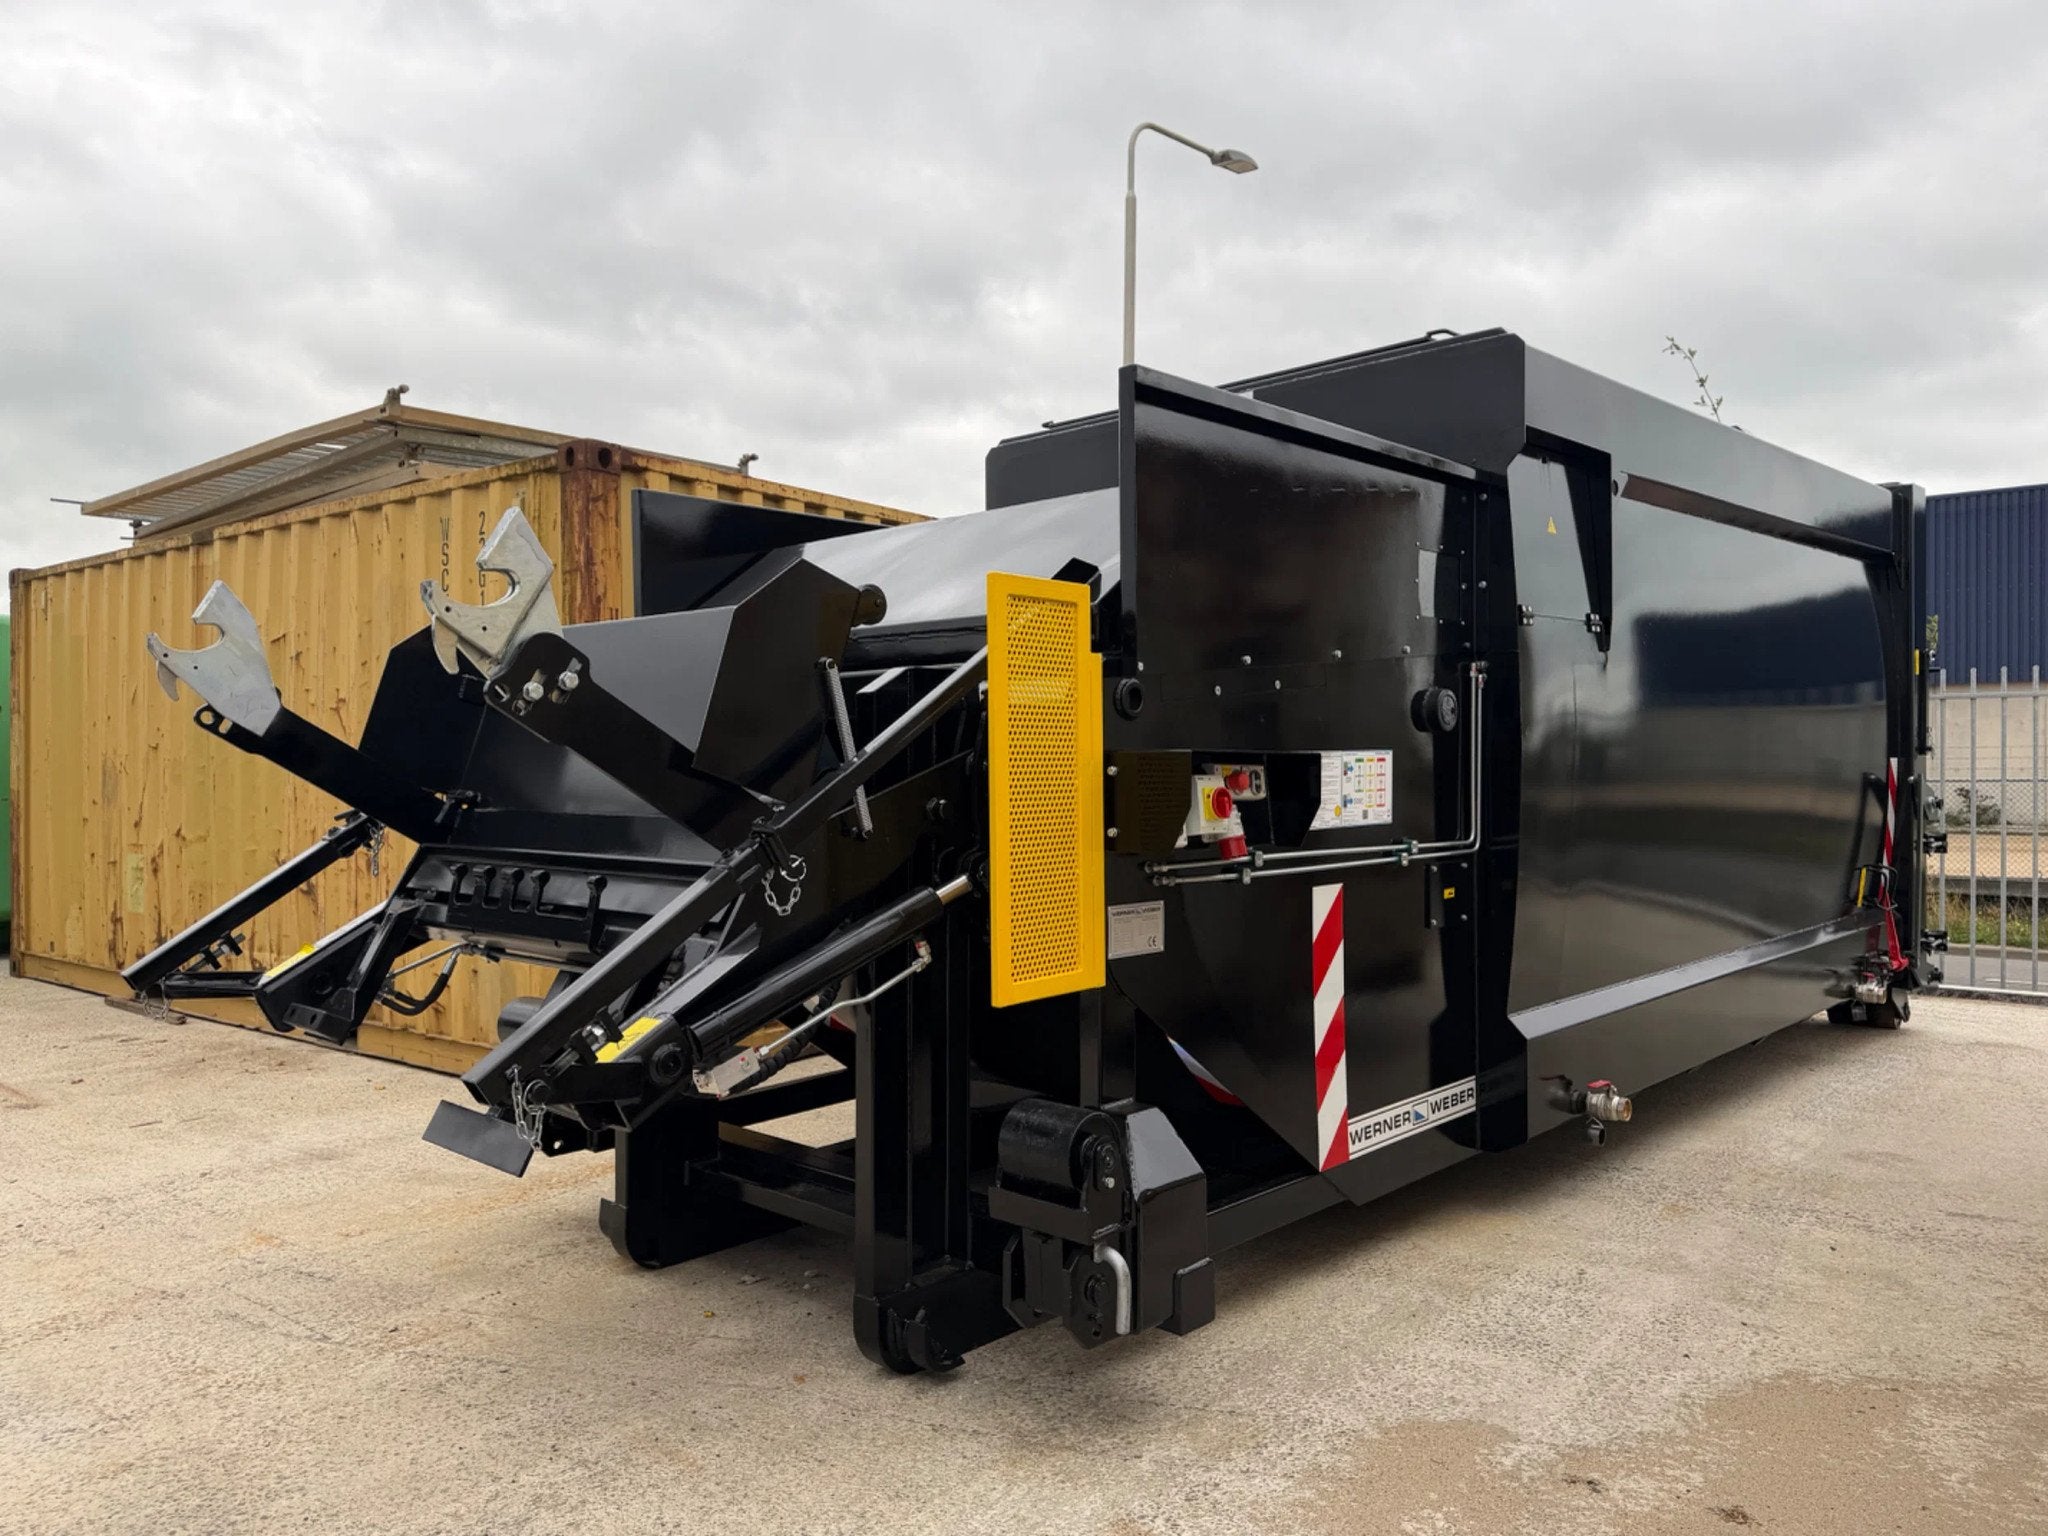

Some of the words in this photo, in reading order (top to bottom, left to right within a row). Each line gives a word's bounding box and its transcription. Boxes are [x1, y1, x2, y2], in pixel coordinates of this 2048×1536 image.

[440, 516, 450, 597] WSC
[1349, 1110, 1411, 1145] WERNER
[1429, 1087, 1475, 1114] WEBER
